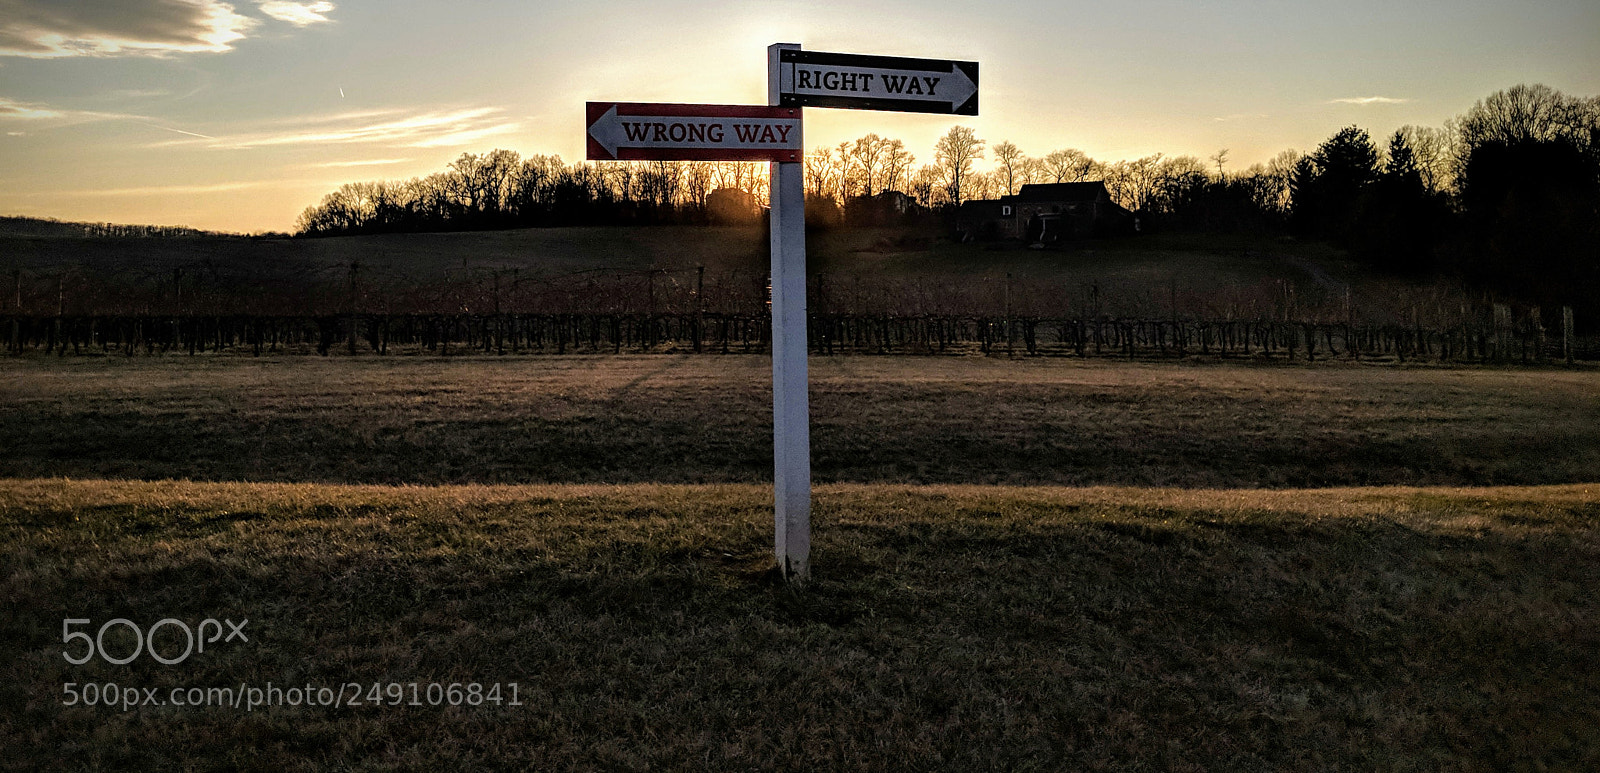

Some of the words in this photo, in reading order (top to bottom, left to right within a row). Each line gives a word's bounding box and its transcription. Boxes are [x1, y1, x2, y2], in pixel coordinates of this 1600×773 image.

[797, 69, 874, 94] RIGHT
[881, 74, 941, 96] WAY
[621, 122, 725, 144] WRONG
[733, 124, 793, 144] WAY
